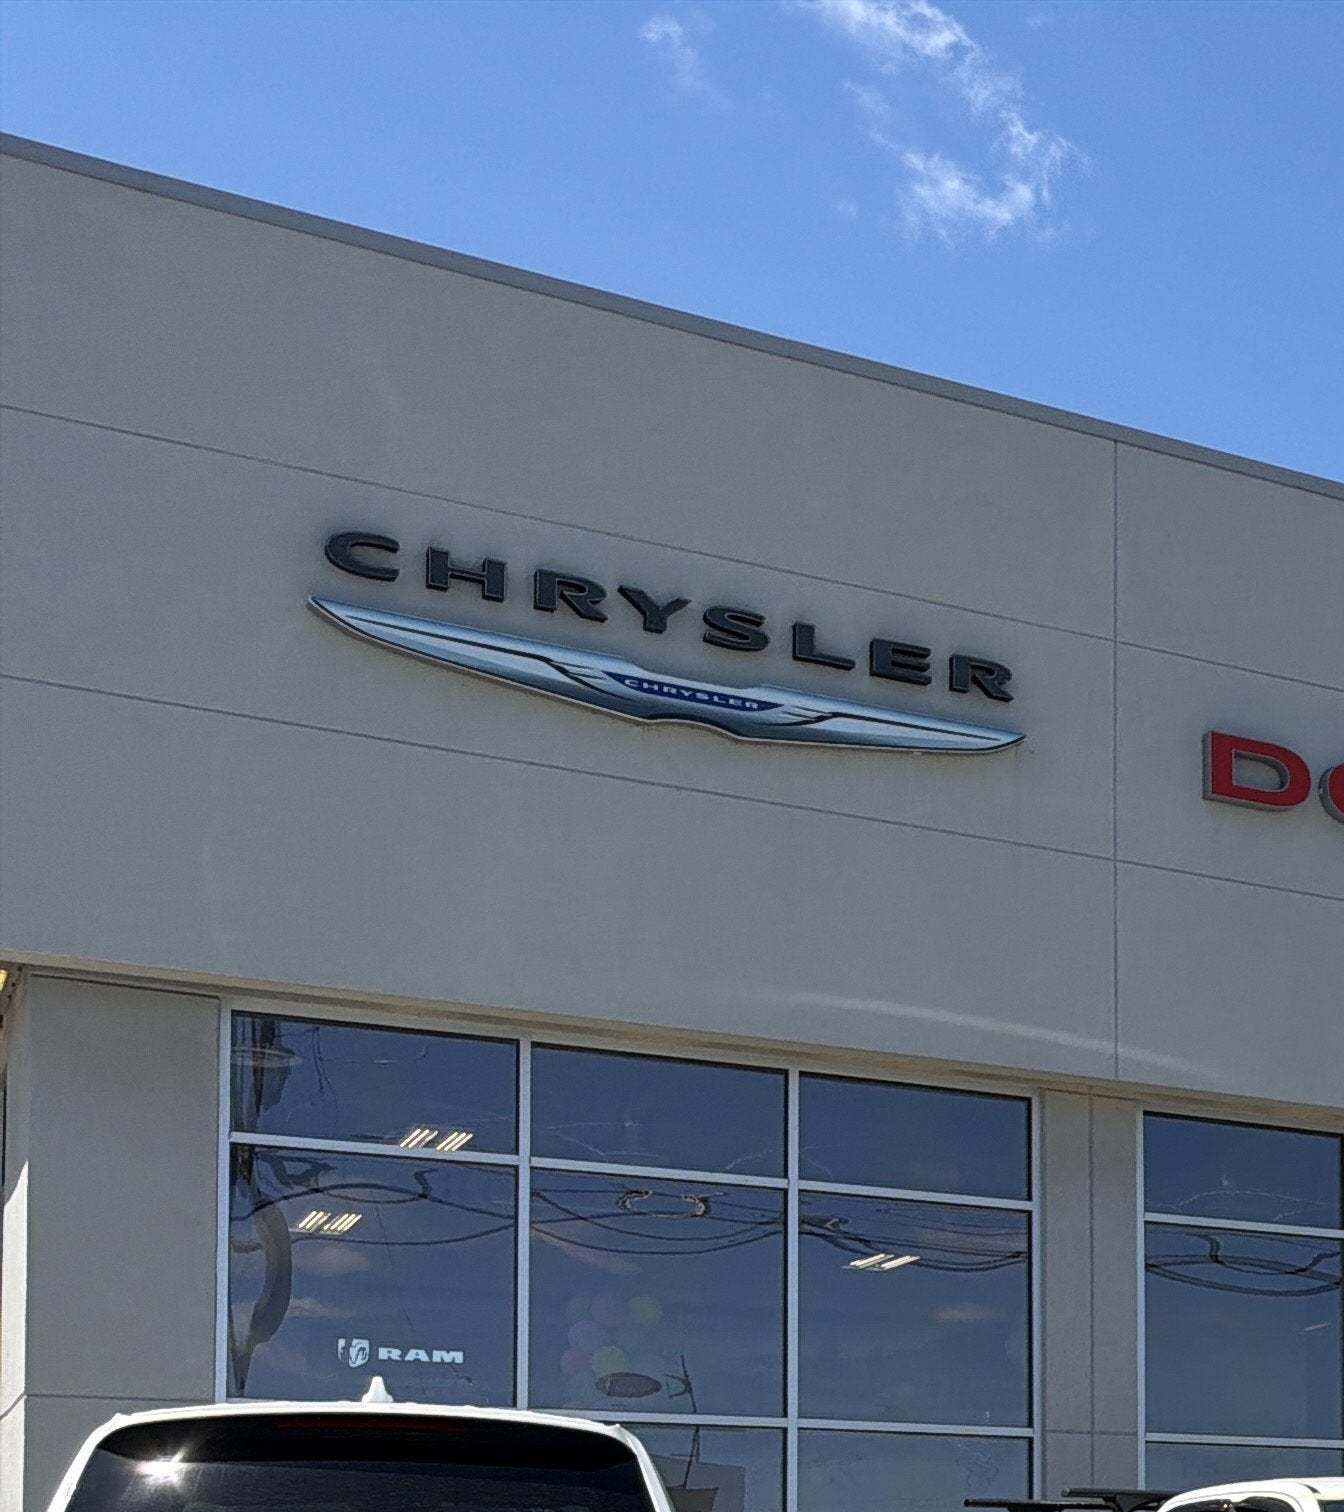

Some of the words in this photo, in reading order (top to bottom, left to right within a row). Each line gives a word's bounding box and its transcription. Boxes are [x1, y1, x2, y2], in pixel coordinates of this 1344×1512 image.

[324, 531, 1015, 703] CHRYSLER
[624, 679, 759, 709] CHRYSLER
[378, 1347, 464, 1364] RAM
